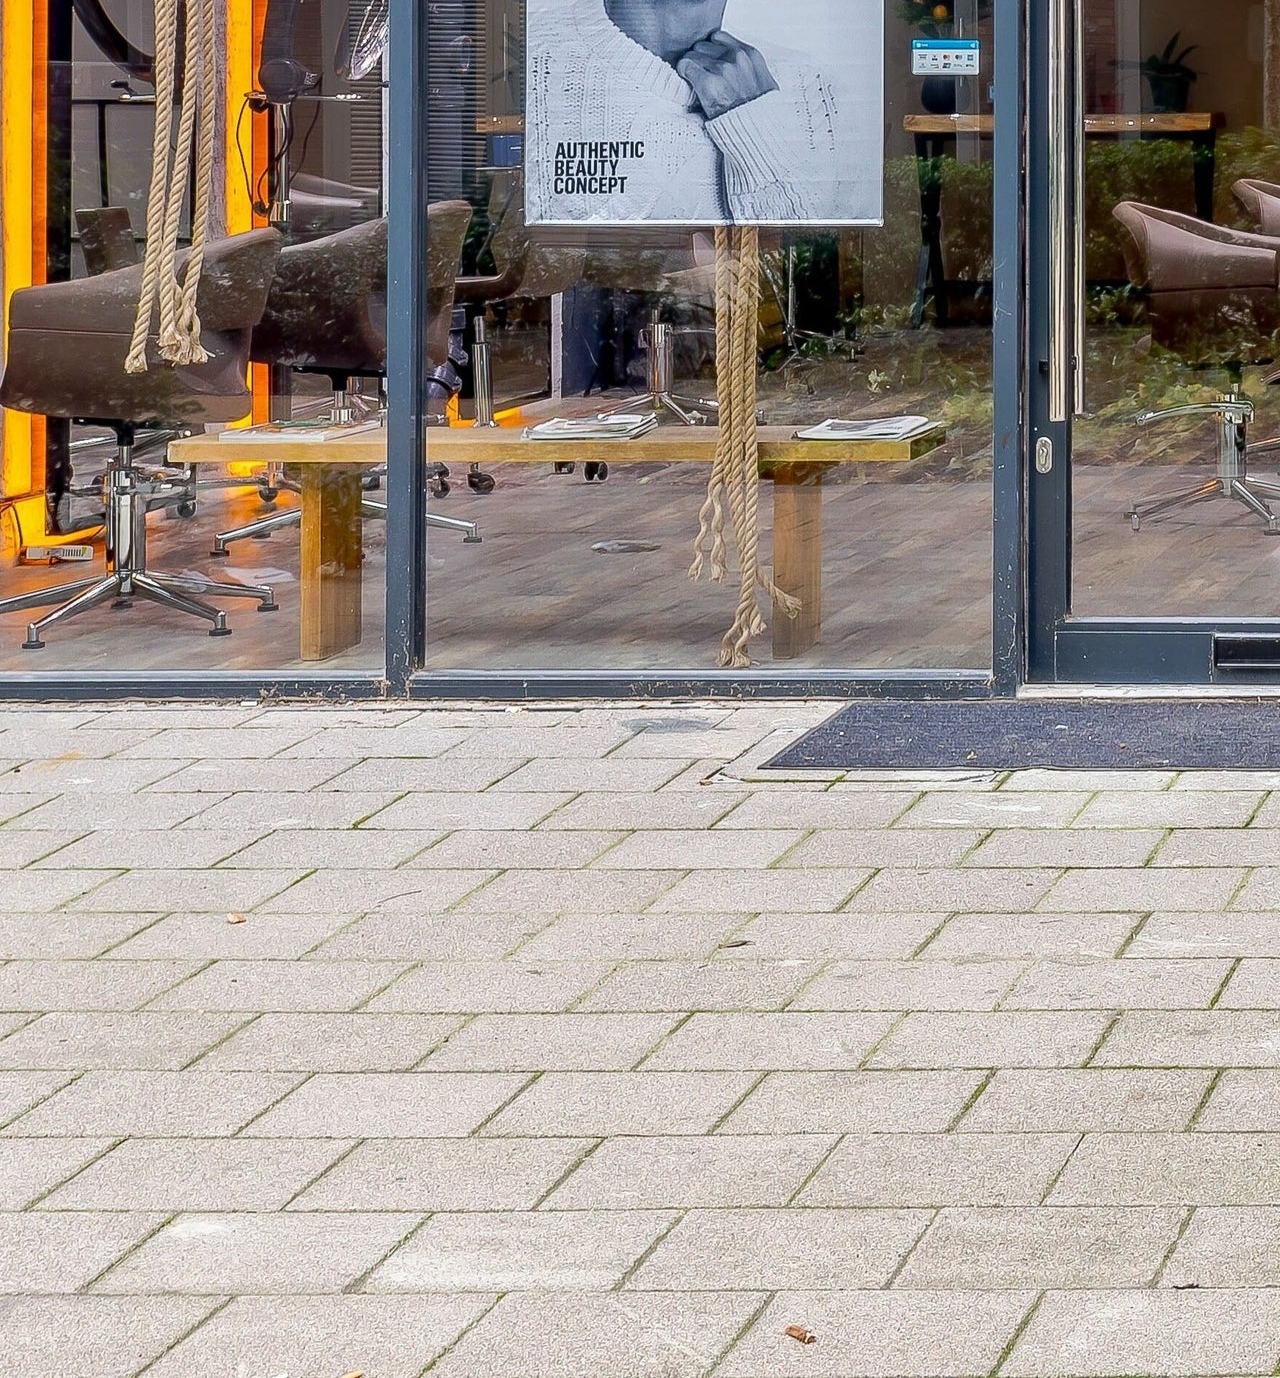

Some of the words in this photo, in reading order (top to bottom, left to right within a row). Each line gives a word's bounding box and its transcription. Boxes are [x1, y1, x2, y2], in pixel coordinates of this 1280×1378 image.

[555, 142, 645, 159] AUTHENTIC
[554, 159, 619, 177] BEAUTY
[553, 177, 628, 194] CONCEPT
